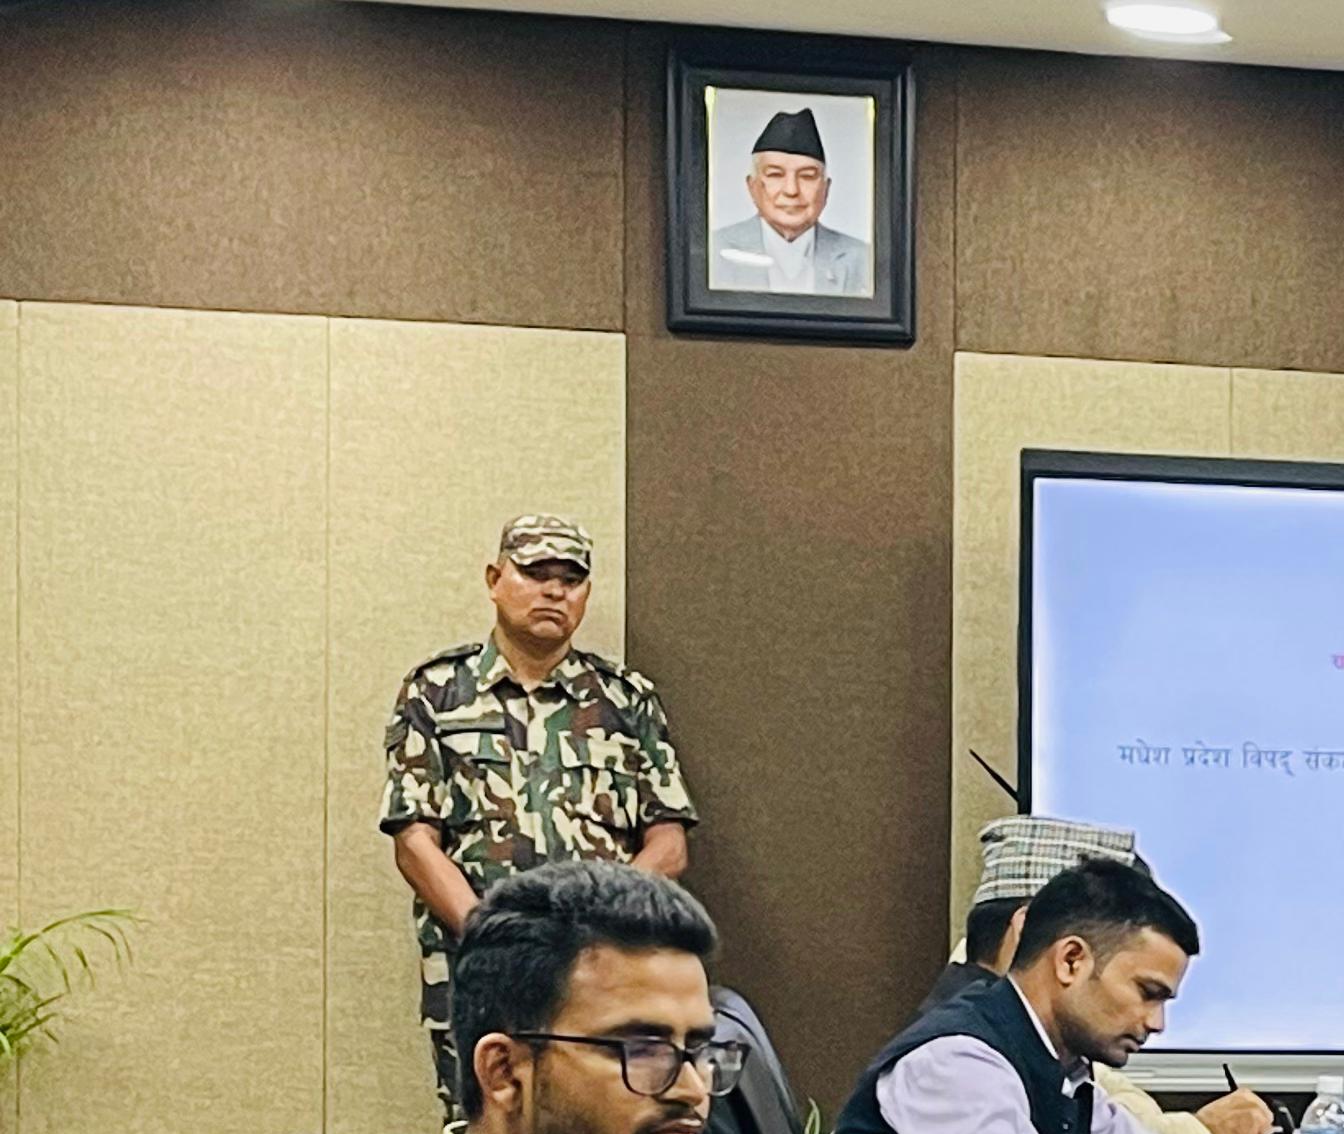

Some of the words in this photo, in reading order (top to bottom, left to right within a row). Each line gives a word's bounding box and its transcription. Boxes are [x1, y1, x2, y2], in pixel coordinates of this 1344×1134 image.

[1118, 738, 1170, 765] मधेश
[1182, 740, 1232, 767] प्रदेश
[1242, 742, 1294, 776] विपद्
